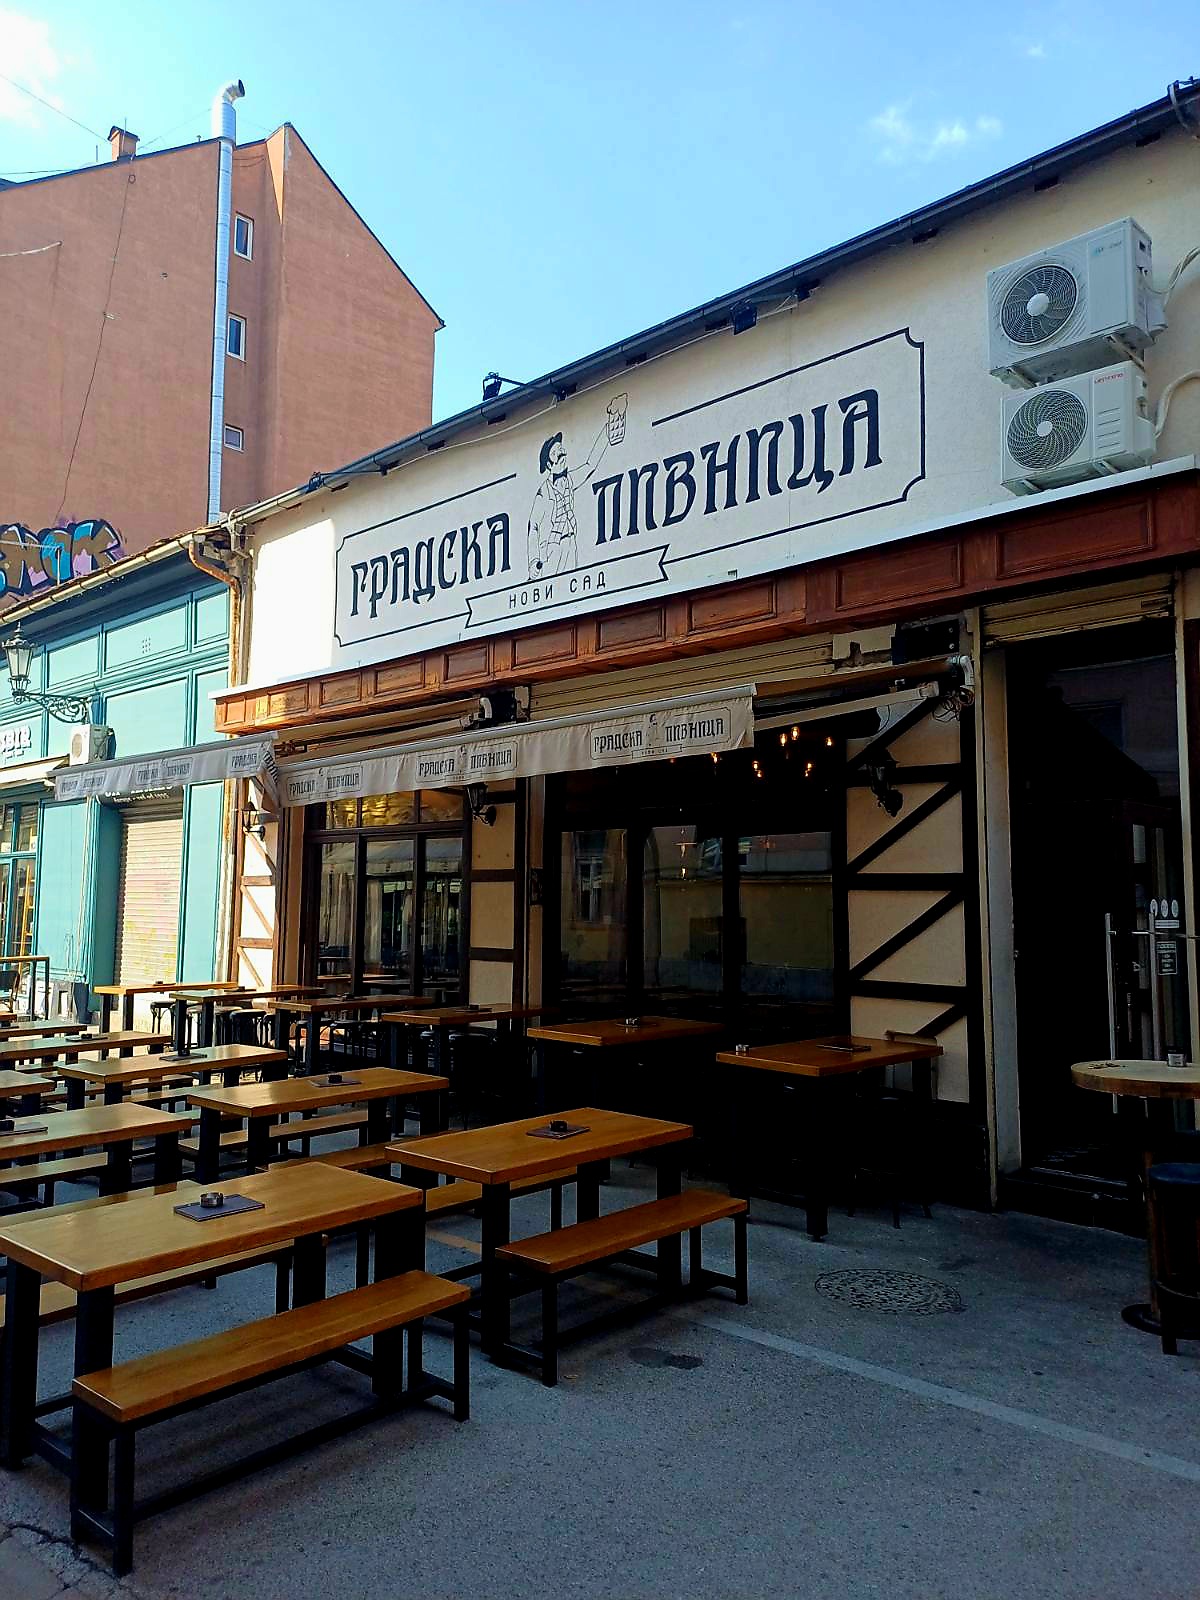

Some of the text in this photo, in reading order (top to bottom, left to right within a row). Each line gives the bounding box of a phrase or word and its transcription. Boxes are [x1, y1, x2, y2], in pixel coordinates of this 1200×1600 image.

[350, 388, 884, 619] ГРАДСКА ПИВНИЦА
[508, 573, 608, 610] НОВИ САД
[593, 717, 724, 754] ГРАДСКА ПИВНИЦА
[419, 758, 455, 778] ГРАДСКА
